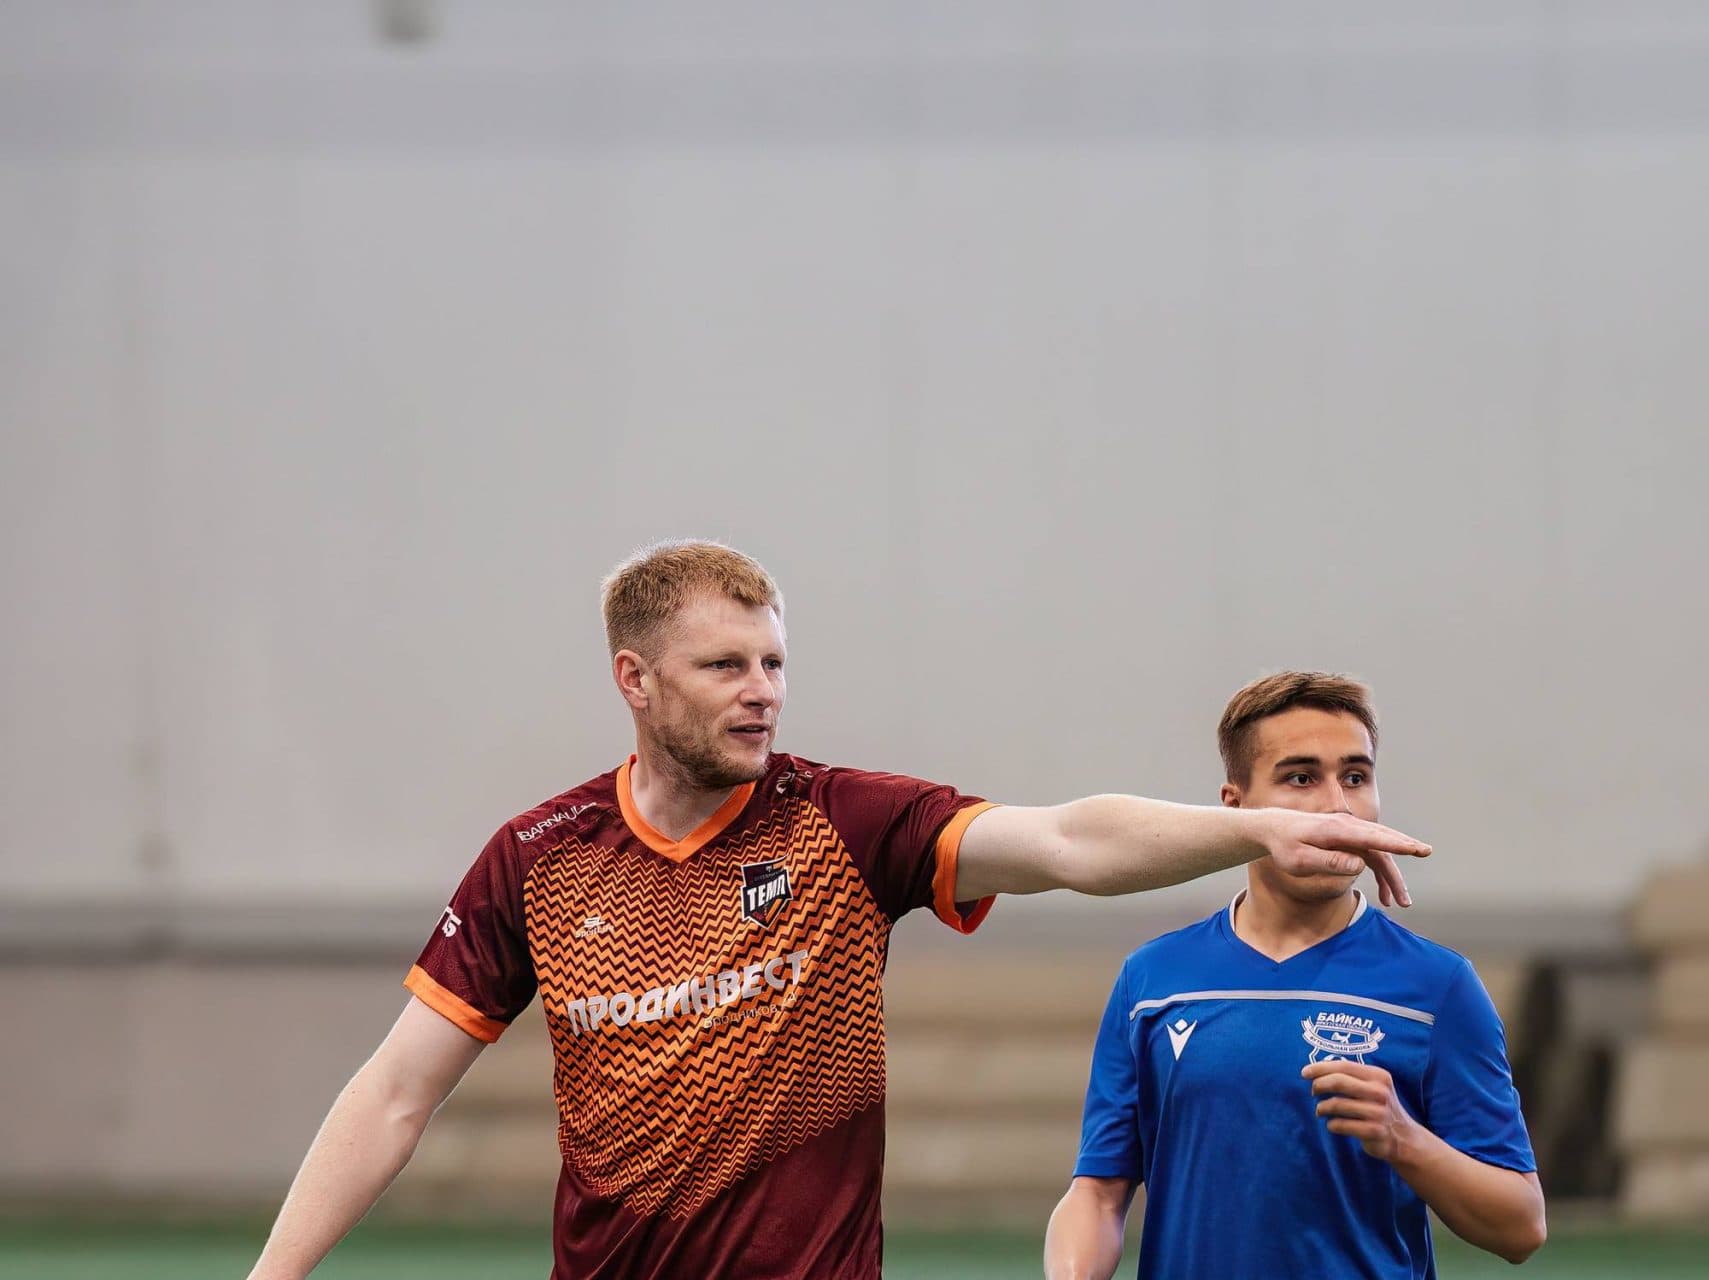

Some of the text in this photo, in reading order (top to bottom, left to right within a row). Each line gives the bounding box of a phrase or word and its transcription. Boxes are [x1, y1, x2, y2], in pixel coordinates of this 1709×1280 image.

[747, 874, 786, 912] ТЕМП
[567, 949, 808, 1037] ПРОДИНВЕСТ
[1316, 1012, 1374, 1029] БАЙКАЛ
